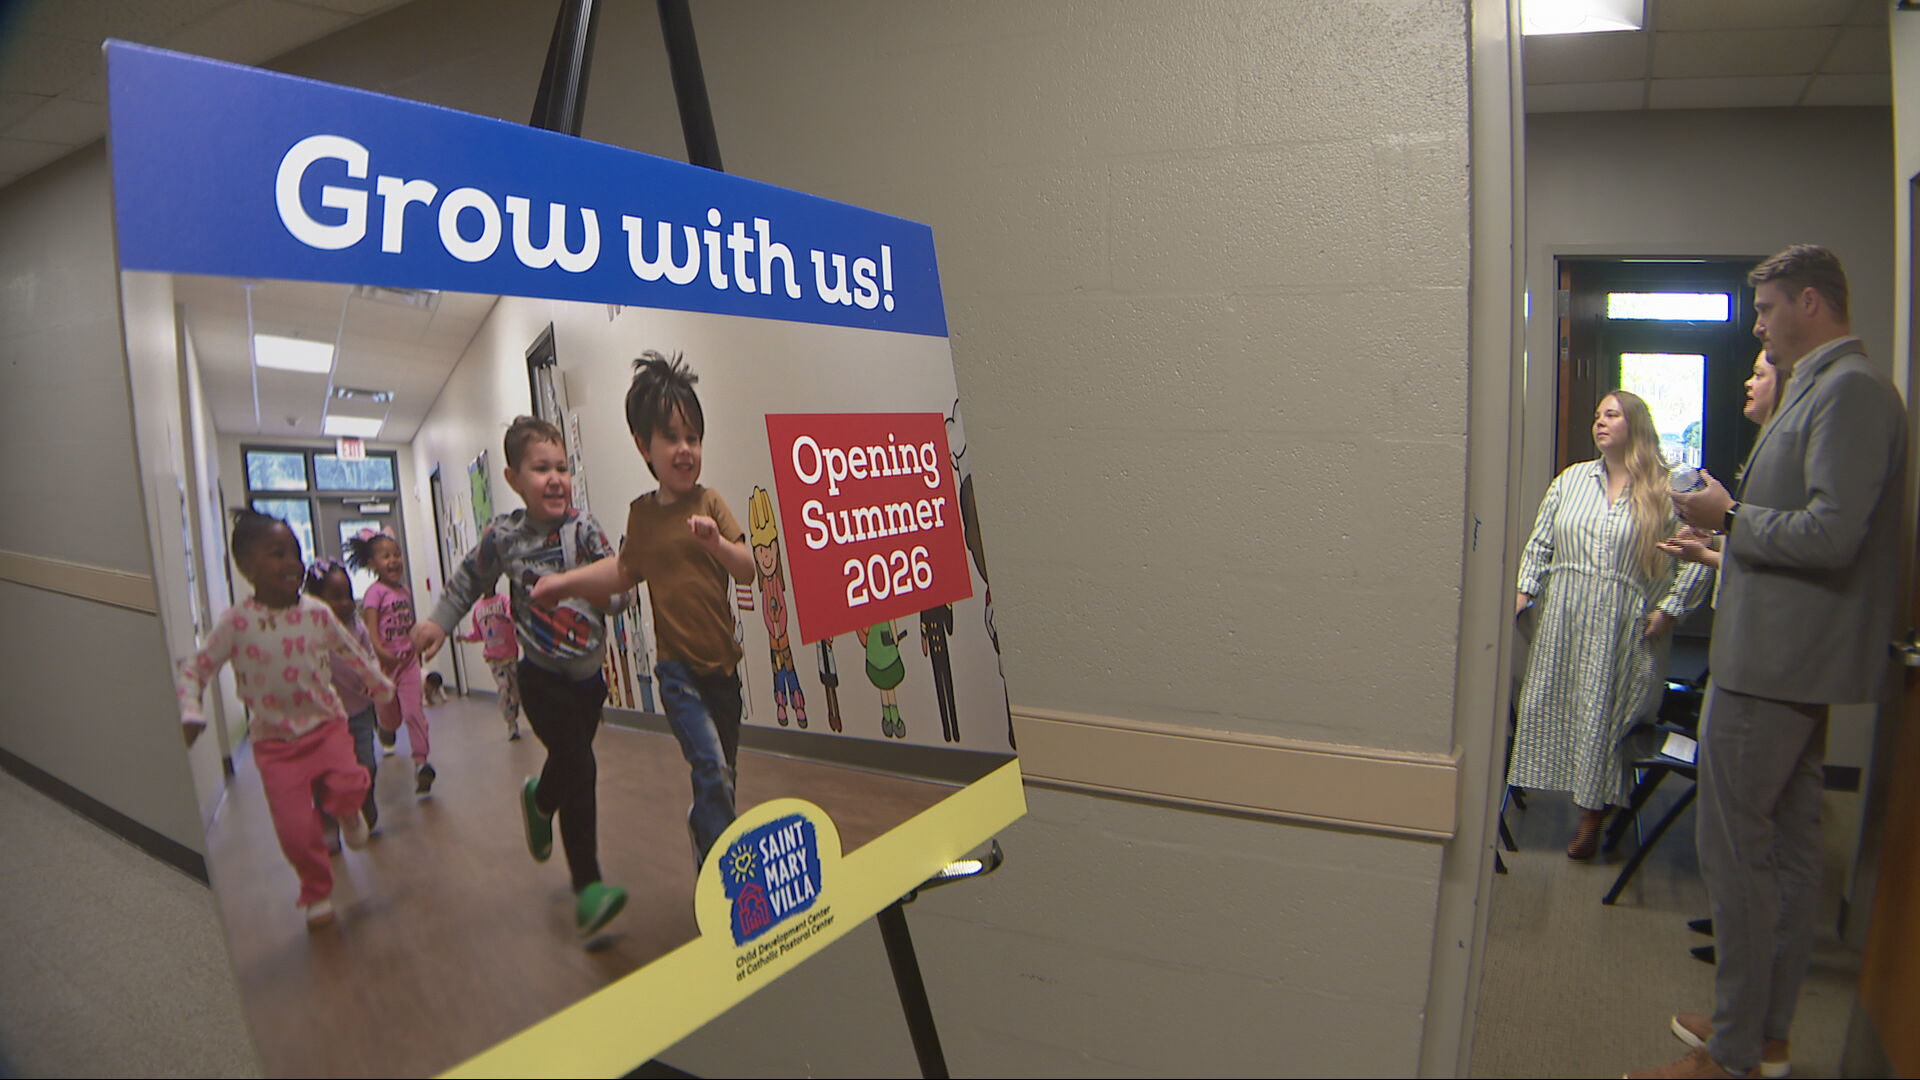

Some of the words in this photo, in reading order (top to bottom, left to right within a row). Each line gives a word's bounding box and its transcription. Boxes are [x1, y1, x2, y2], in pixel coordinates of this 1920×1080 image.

[275, 134, 600, 273] Grow
[622, 207, 801, 299] with
[810, 244, 896, 312] us!
[792, 433, 941, 496] Opening
[802, 496, 946, 550] Summer
[843, 546, 933, 608] 2026
[759, 820, 803, 865] SAINT
[764, 847, 807, 892] MARY
[769, 874, 816, 918] VILLA
[736, 948, 757, 969] Child
[758, 919, 807, 956] Development
[807, 905, 831, 925] Center
[736, 969, 746, 982] at
[746, 949, 779, 975] Catholic
[780, 927, 811, 956] Pastoral
[811, 915, 834, 936] Center
